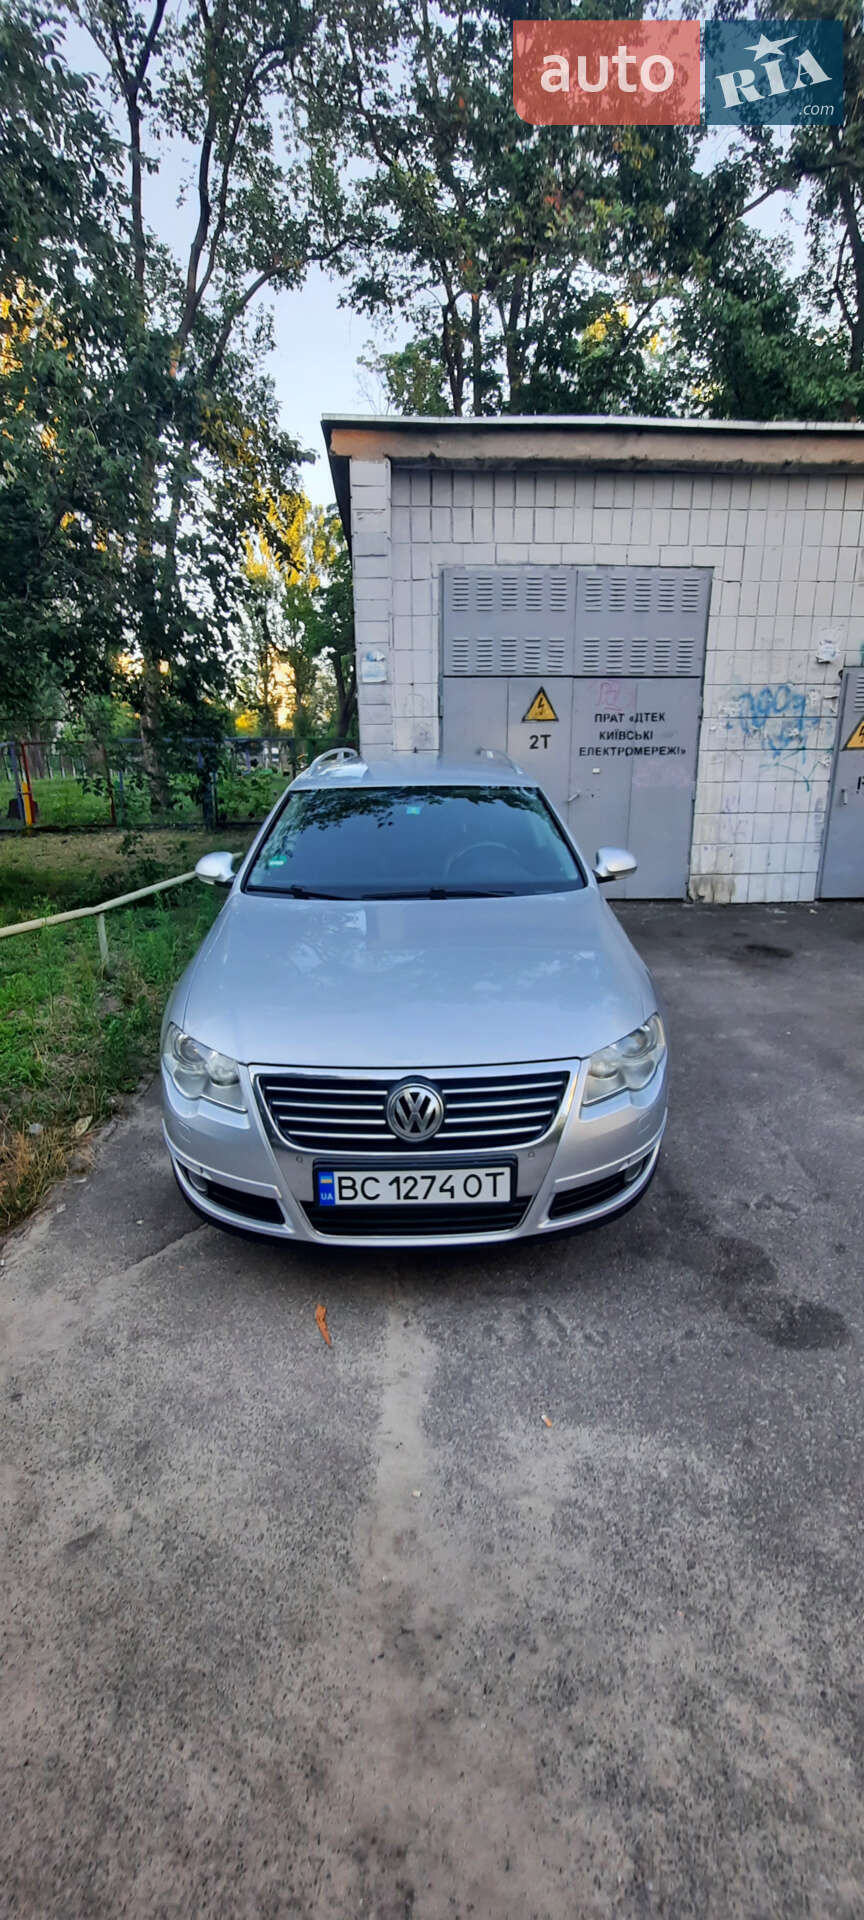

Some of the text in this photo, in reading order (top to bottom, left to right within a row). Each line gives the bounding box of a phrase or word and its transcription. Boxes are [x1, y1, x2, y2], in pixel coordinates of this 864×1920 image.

[594, 713, 624, 723] ПРАТ
[599, 730, 653, 741] КИЇВСЬКІ
[337, 1176, 380, 1201] BC
[387, 1175, 455, 1200] 1274
[321, 1193, 333, 1201] UA
